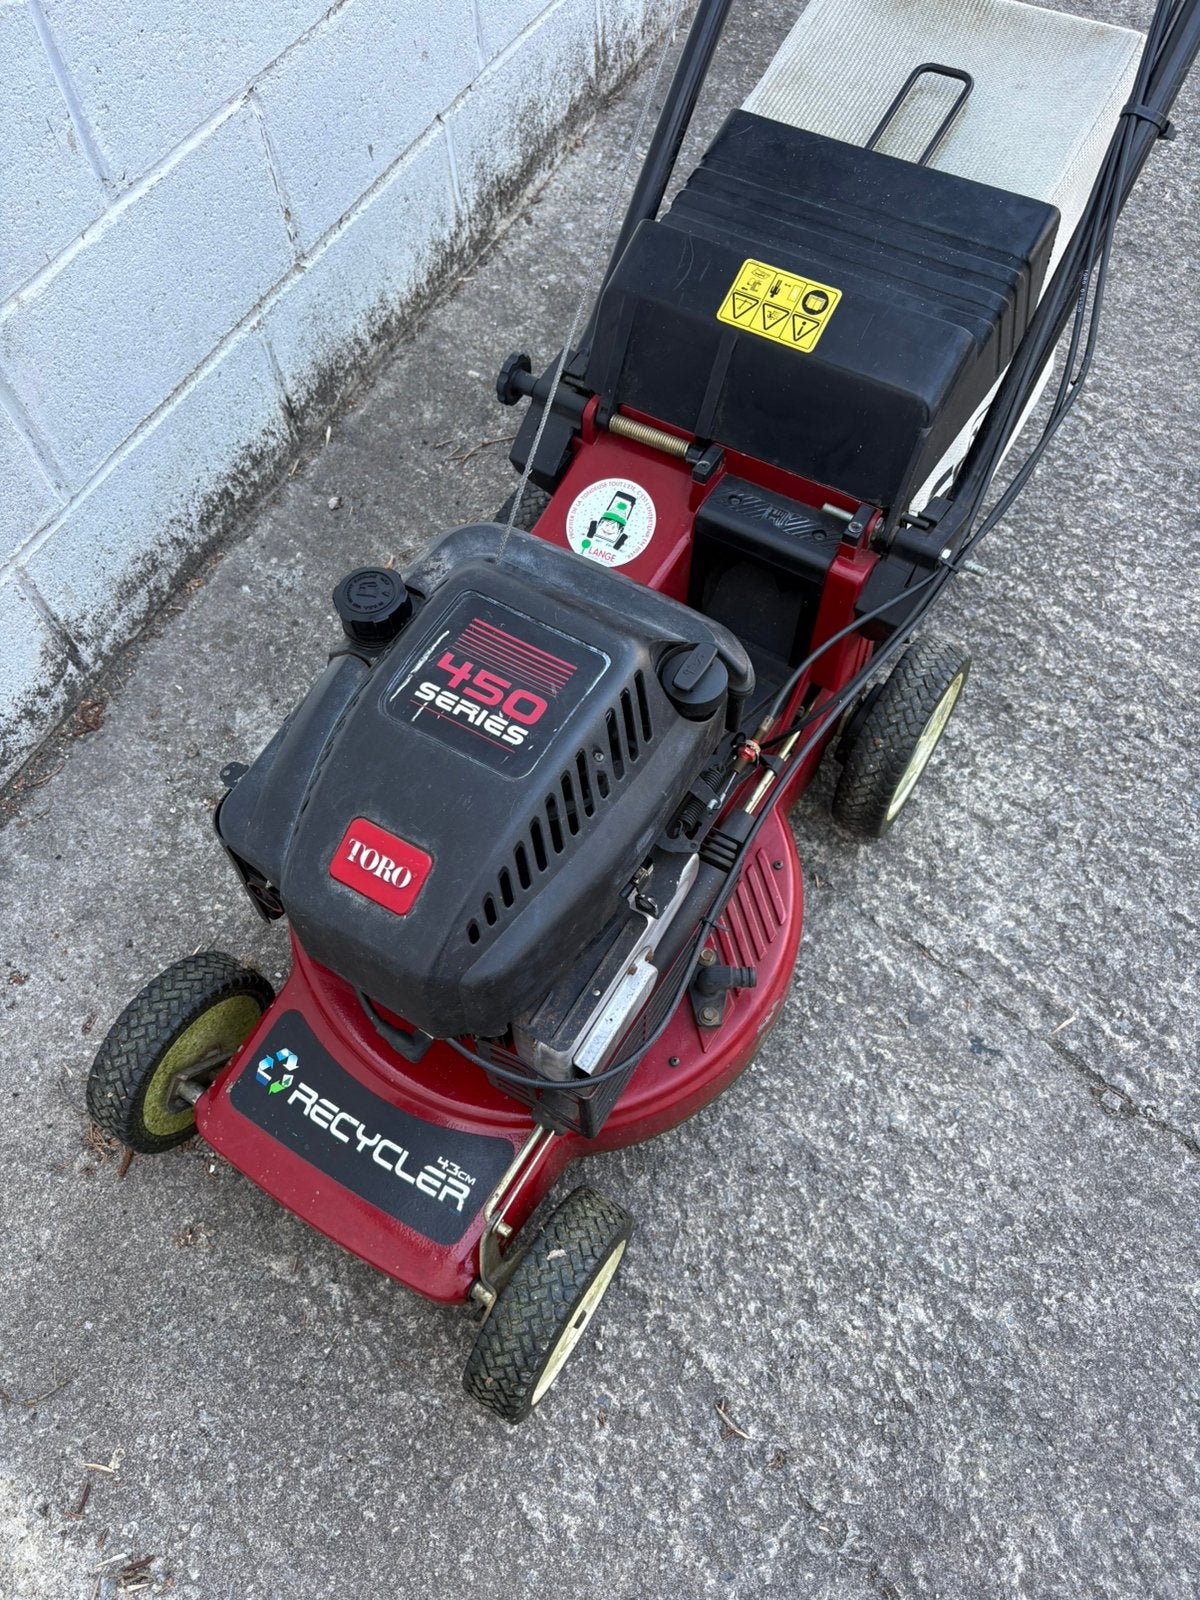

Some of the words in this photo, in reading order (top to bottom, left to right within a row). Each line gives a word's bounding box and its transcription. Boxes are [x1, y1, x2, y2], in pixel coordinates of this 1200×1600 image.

[581, 482, 607, 500] TONDEUSE
[588, 547, 616, 563] LANGE
[414, 681, 529, 746] SERIES
[437, 652, 548, 725] 450
[347, 838, 412, 888] TORO
[287, 1082, 471, 1213] RECYCLER
